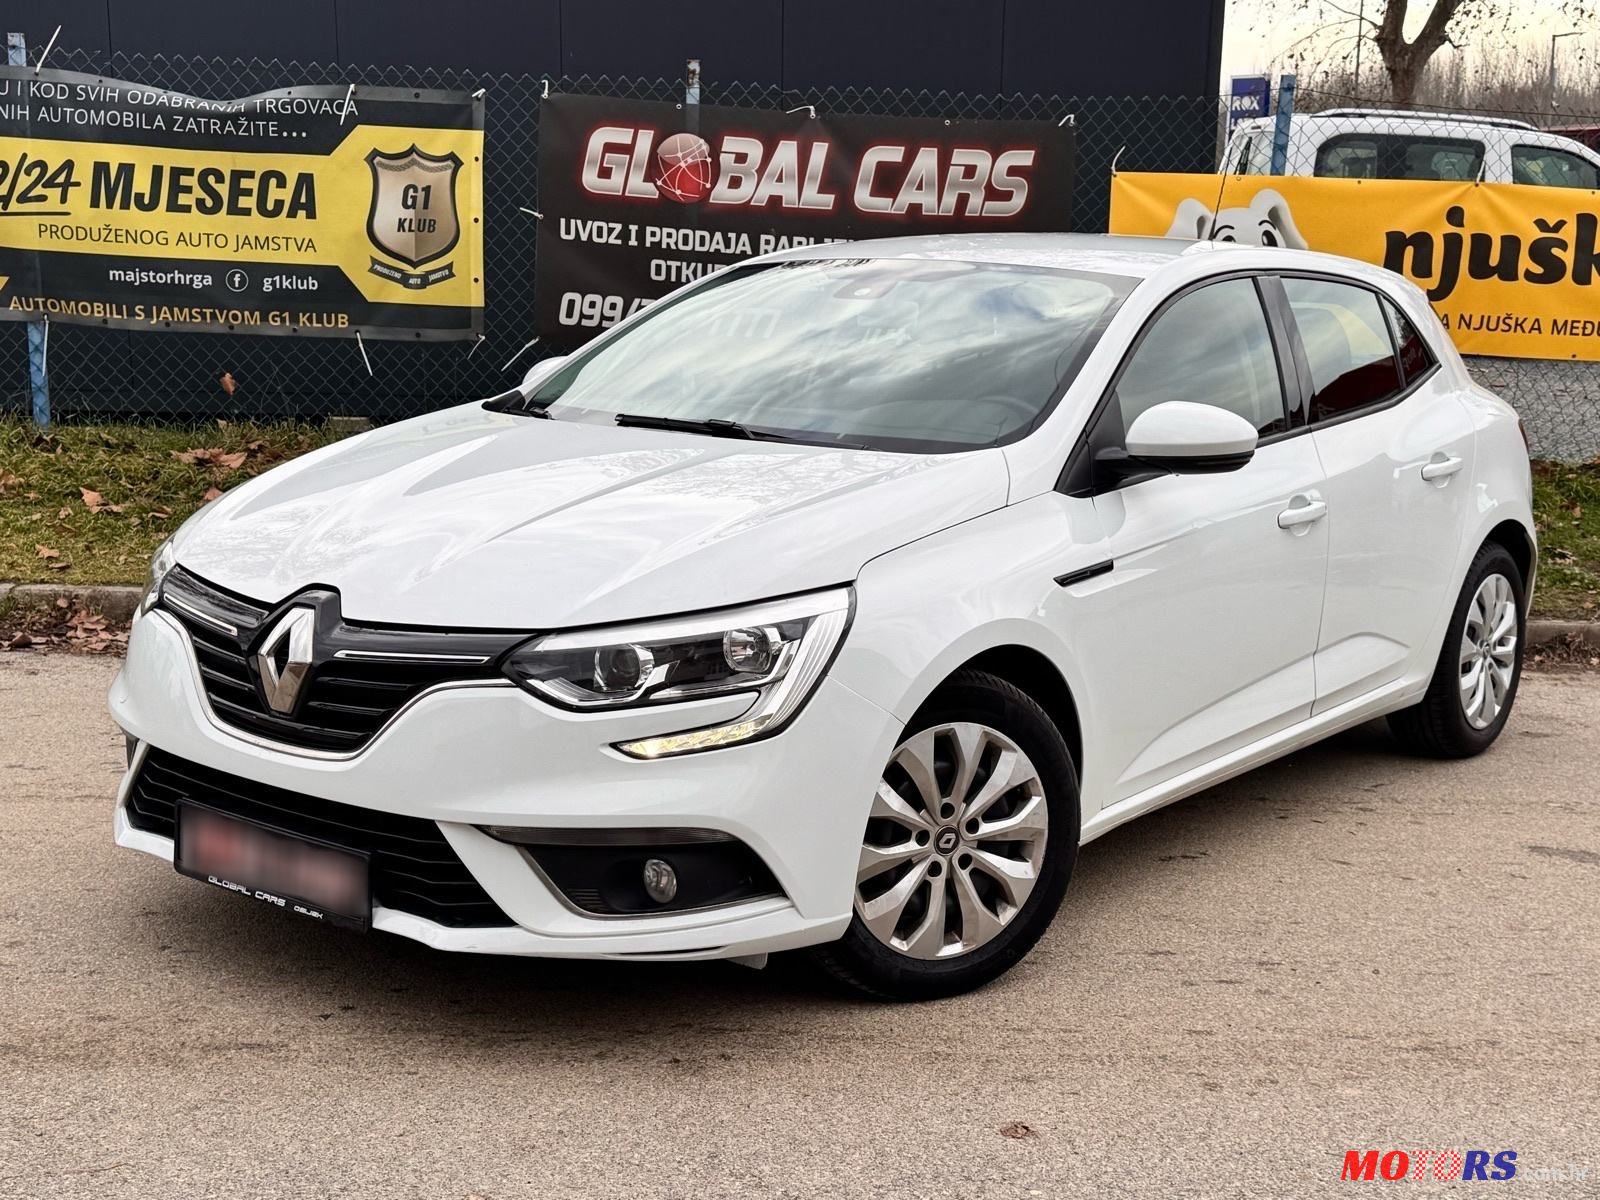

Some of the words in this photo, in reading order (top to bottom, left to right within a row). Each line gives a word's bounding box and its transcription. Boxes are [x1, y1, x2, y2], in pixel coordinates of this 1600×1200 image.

[17, 80, 21, 97] I
[30, 81, 69, 100] KOD
[76, 85, 120, 103] SVIH
[127, 90, 245, 113] ODABRANIH
[253, 98, 358, 116] TRGOVACA
[37, 106, 166, 131] AUTOMOBILA
[173, 116, 307, 137] ZATRAŽITE...
[581, 126, 836, 210] GLOBAL
[853, 145, 1036, 217] CARS
[89, 161, 317, 220] MJESECA
[401, 183, 432, 210] G1
[38, 223, 169, 246] PRODUŽENOG
[176, 232, 228, 249] AUTO
[233, 234, 317, 253] JAMSTVA
[396, 217, 437, 233] KLUB
[559, 217, 622, 245] UVOZ
[628, 225, 639, 246] I
[645, 226, 752, 255] PRODAJA
[109, 268, 213, 289] majstorhrga
[262, 275, 318, 292] g1klub
[650, 259, 731, 283] OTKU
[9, 296, 127, 319] AUTOMOBILI
[135, 305, 145, 320] S
[150, 306, 261, 326] JAMSTVOM
[268, 311, 290, 326] G1
[300, 312, 349, 328] KLUB
[1457, 313, 1542, 334] NJUŠKA
[207, 875, 251, 896] GLOBAL
[254, 890, 286, 907] CARS
